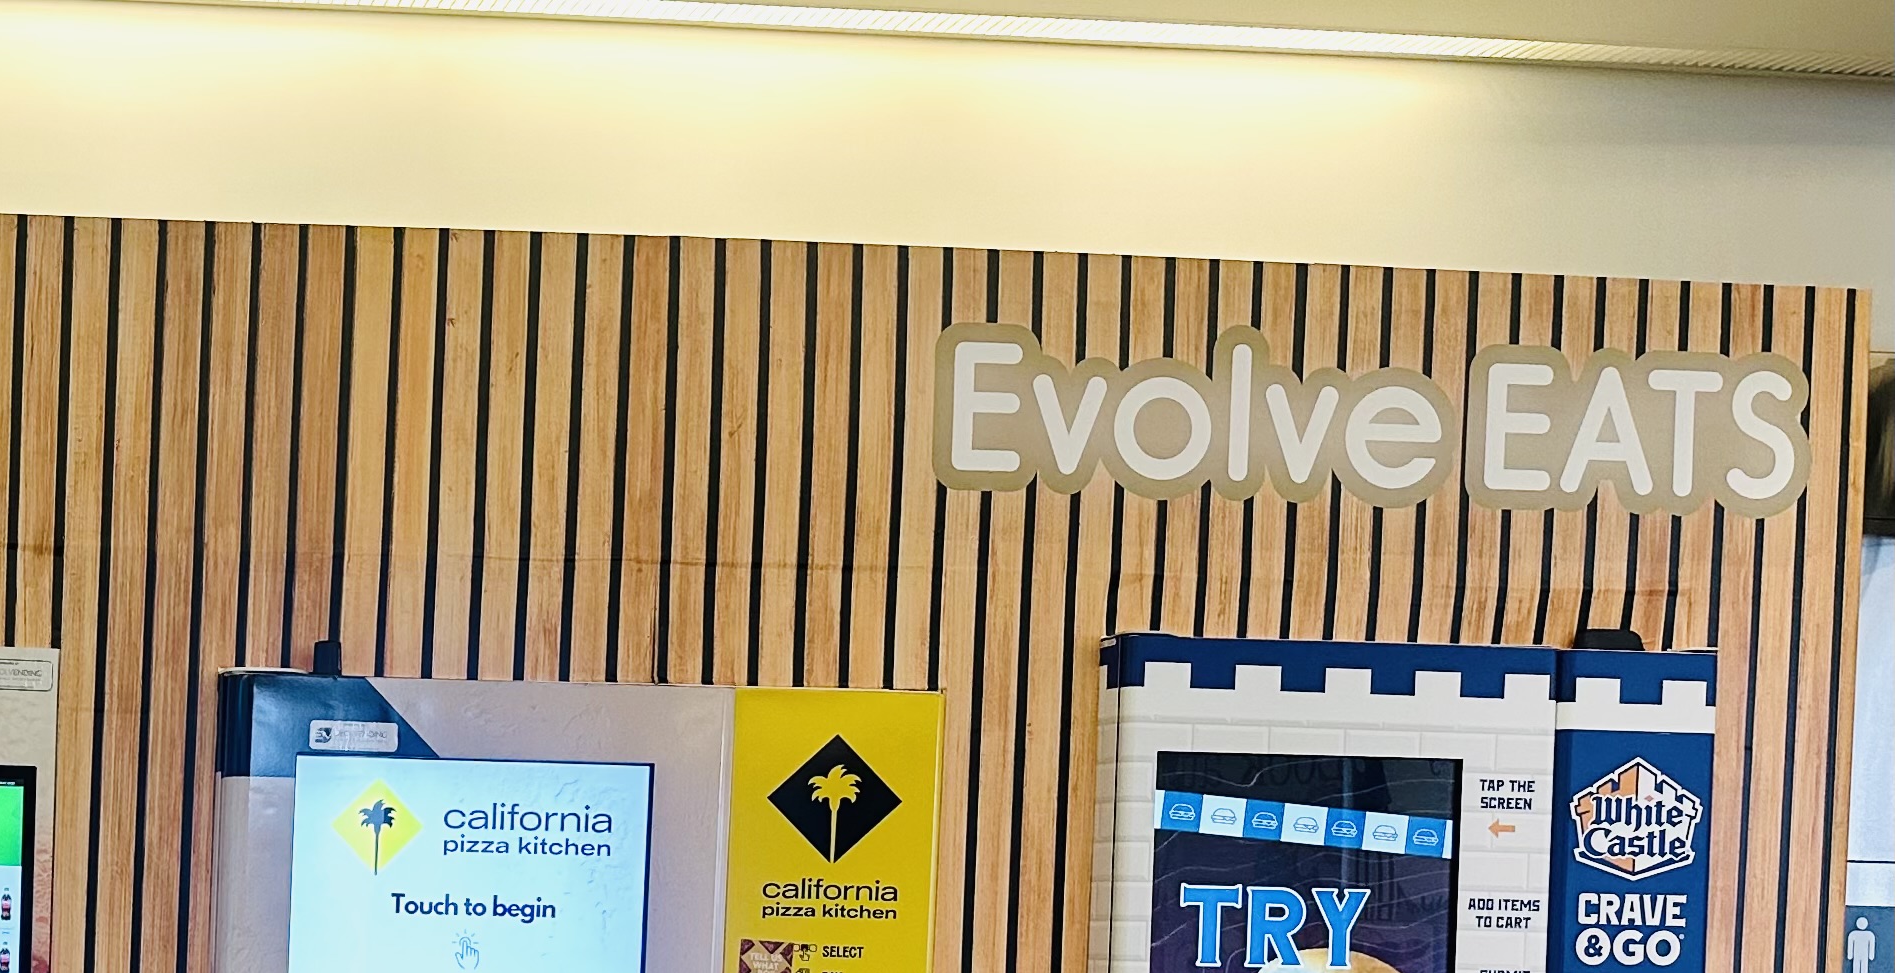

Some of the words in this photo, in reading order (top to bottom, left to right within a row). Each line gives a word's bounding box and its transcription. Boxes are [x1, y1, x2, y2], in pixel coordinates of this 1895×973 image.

[952, 342, 1442, 489] Evolve
[1483, 362, 1797, 501] EATS
[1480, 779, 1504, 791] TAP
[1509, 780, 1535, 792] THE
[1481, 797, 1532, 810] SCREEN
[1591, 796, 1683, 831] White
[443, 802, 613, 834] california
[443, 834, 510, 856] pizza
[518, 836, 611, 857] kitchen
[1584, 828, 1686, 858] Castle
[762, 879, 898, 902] california
[391, 893, 458, 916] Touch
[465, 896, 487, 917] to
[493, 895, 556, 923] begin
[762, 903, 816, 920] pizza
[822, 903, 897, 920] kitchen
[1468, 898, 1494, 910] ADD
[1498, 899, 1540, 912] ITEMS
[1578, 893, 1687, 927] CRAVE
[1180, 883, 1371, 970] TRY
[1476, 916, 1492, 928] TO
[1496, 917, 1531, 929] CART
[822, 946, 864, 958] SELECT
[753, 962, 778, 970] WHAT
